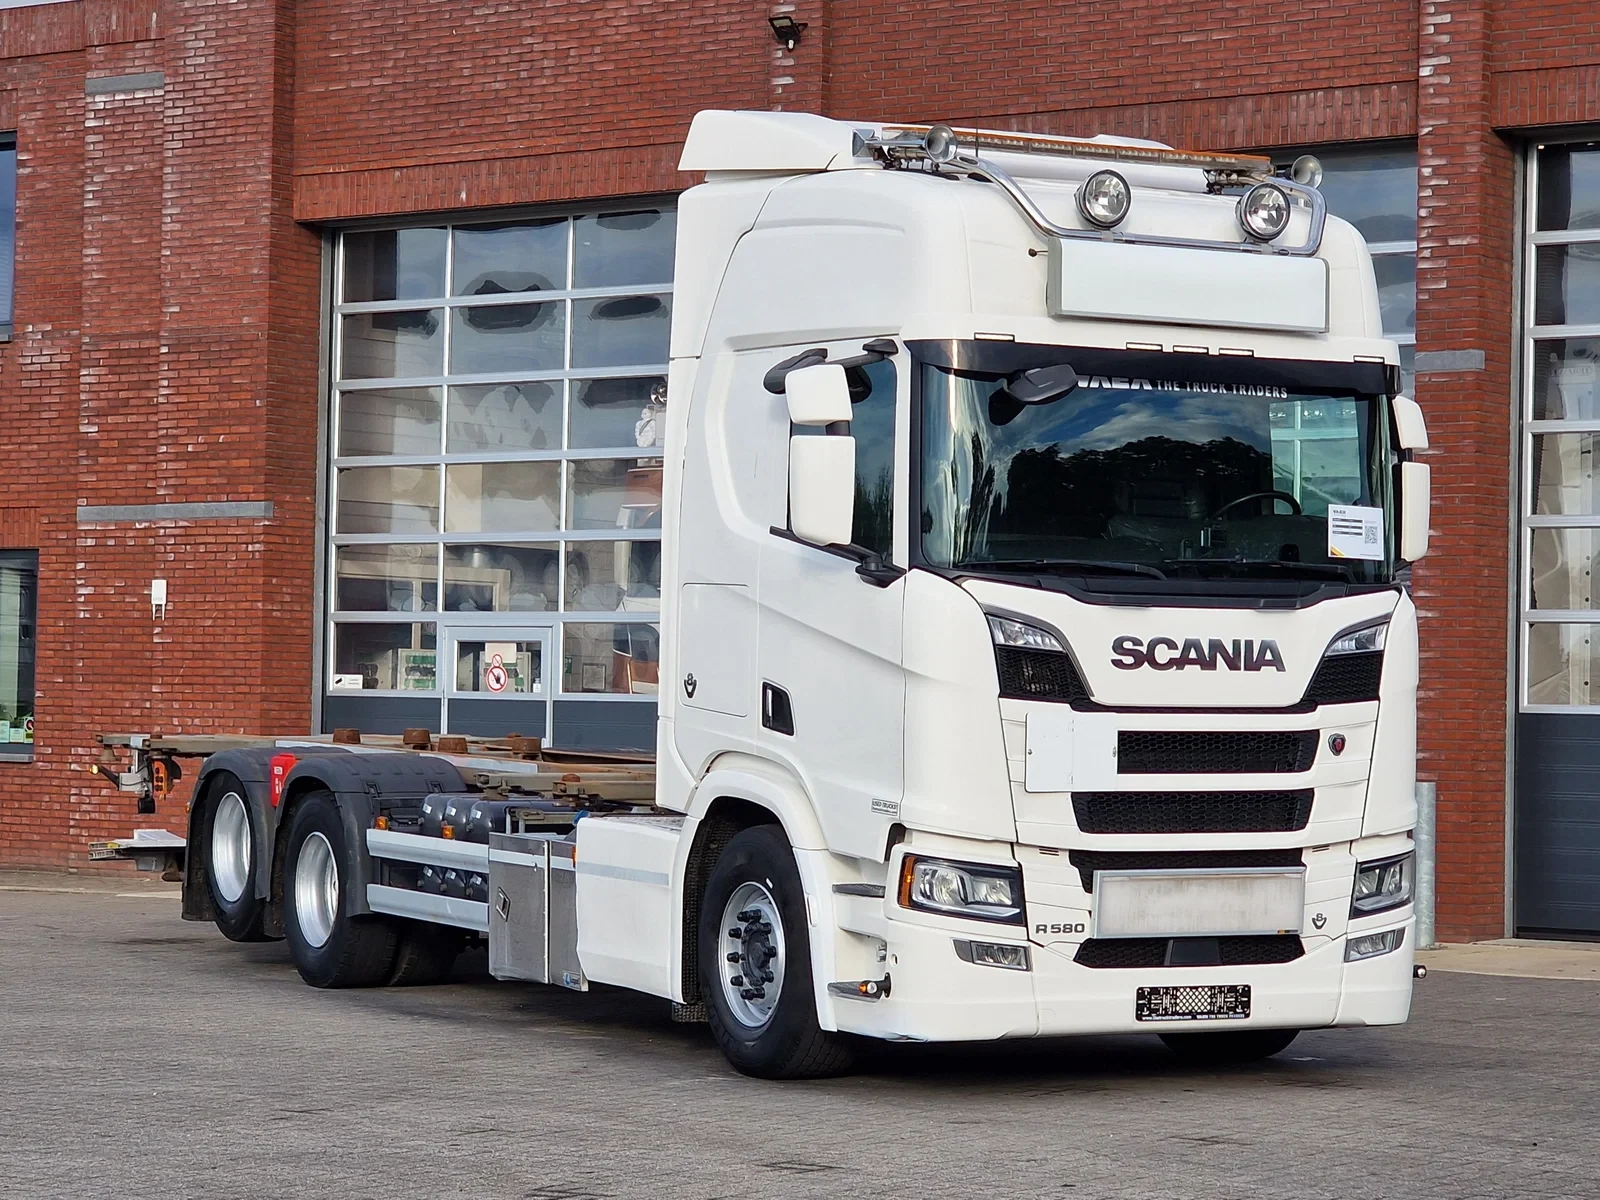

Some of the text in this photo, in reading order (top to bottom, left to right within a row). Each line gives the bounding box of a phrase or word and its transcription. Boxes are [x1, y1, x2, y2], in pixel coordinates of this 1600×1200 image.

[1156, 379, 1180, 391] THE
[1185, 381, 1228, 394] TRUCK
[1231, 383, 1288, 399] TRADERS
[1110, 635, 1287, 672] SCANIA
[1035, 923, 1085, 934] R 580
